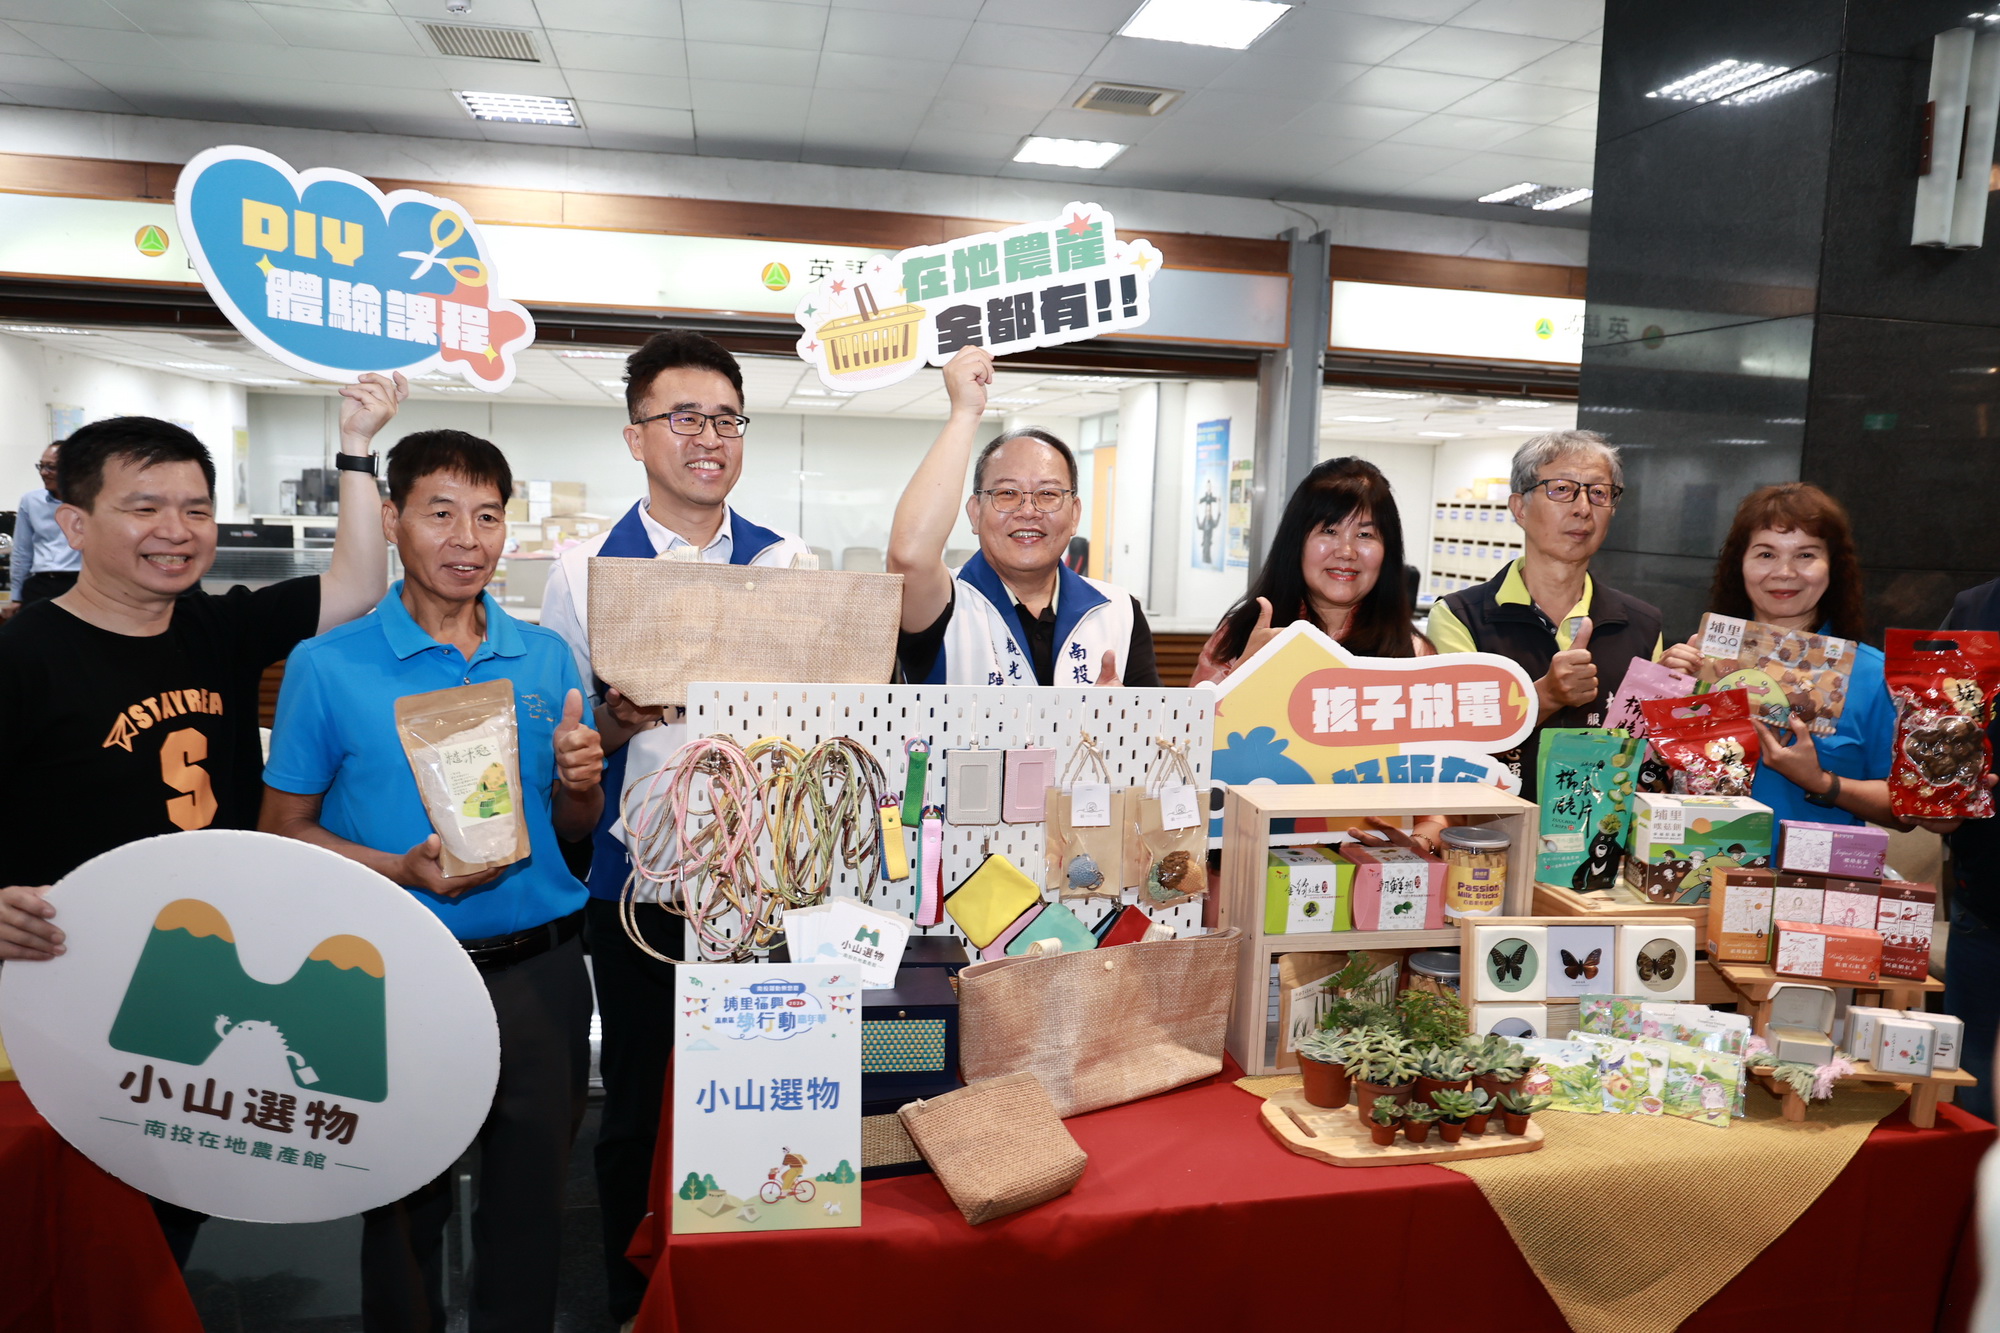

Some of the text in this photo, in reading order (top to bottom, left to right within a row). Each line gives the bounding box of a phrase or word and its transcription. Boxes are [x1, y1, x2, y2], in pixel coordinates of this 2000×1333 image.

[242, 198, 364, 267] DIY
[901, 221, 1107, 303] 在地農產
[265, 267, 490, 355] 體驗課程
[935, 273, 1139, 355] 全都有!!
[1709, 620, 1742, 637] 埔里
[1069, 642, 1094, 684] 南投
[1311, 681, 1502, 734] 孩子放電
[159, 727, 219, 831] S
[1457, 881, 1500, 892] Passion
[1457, 890, 1473, 899] Milk
[841, 939, 885, 962] 小山選物
[723, 996, 784, 1013] 埔里福興
[119, 1064, 360, 1146] 小山選物
[695, 1076, 841, 1114] 小山選物
[143, 1118, 328, 1171] 南投在地農產館
